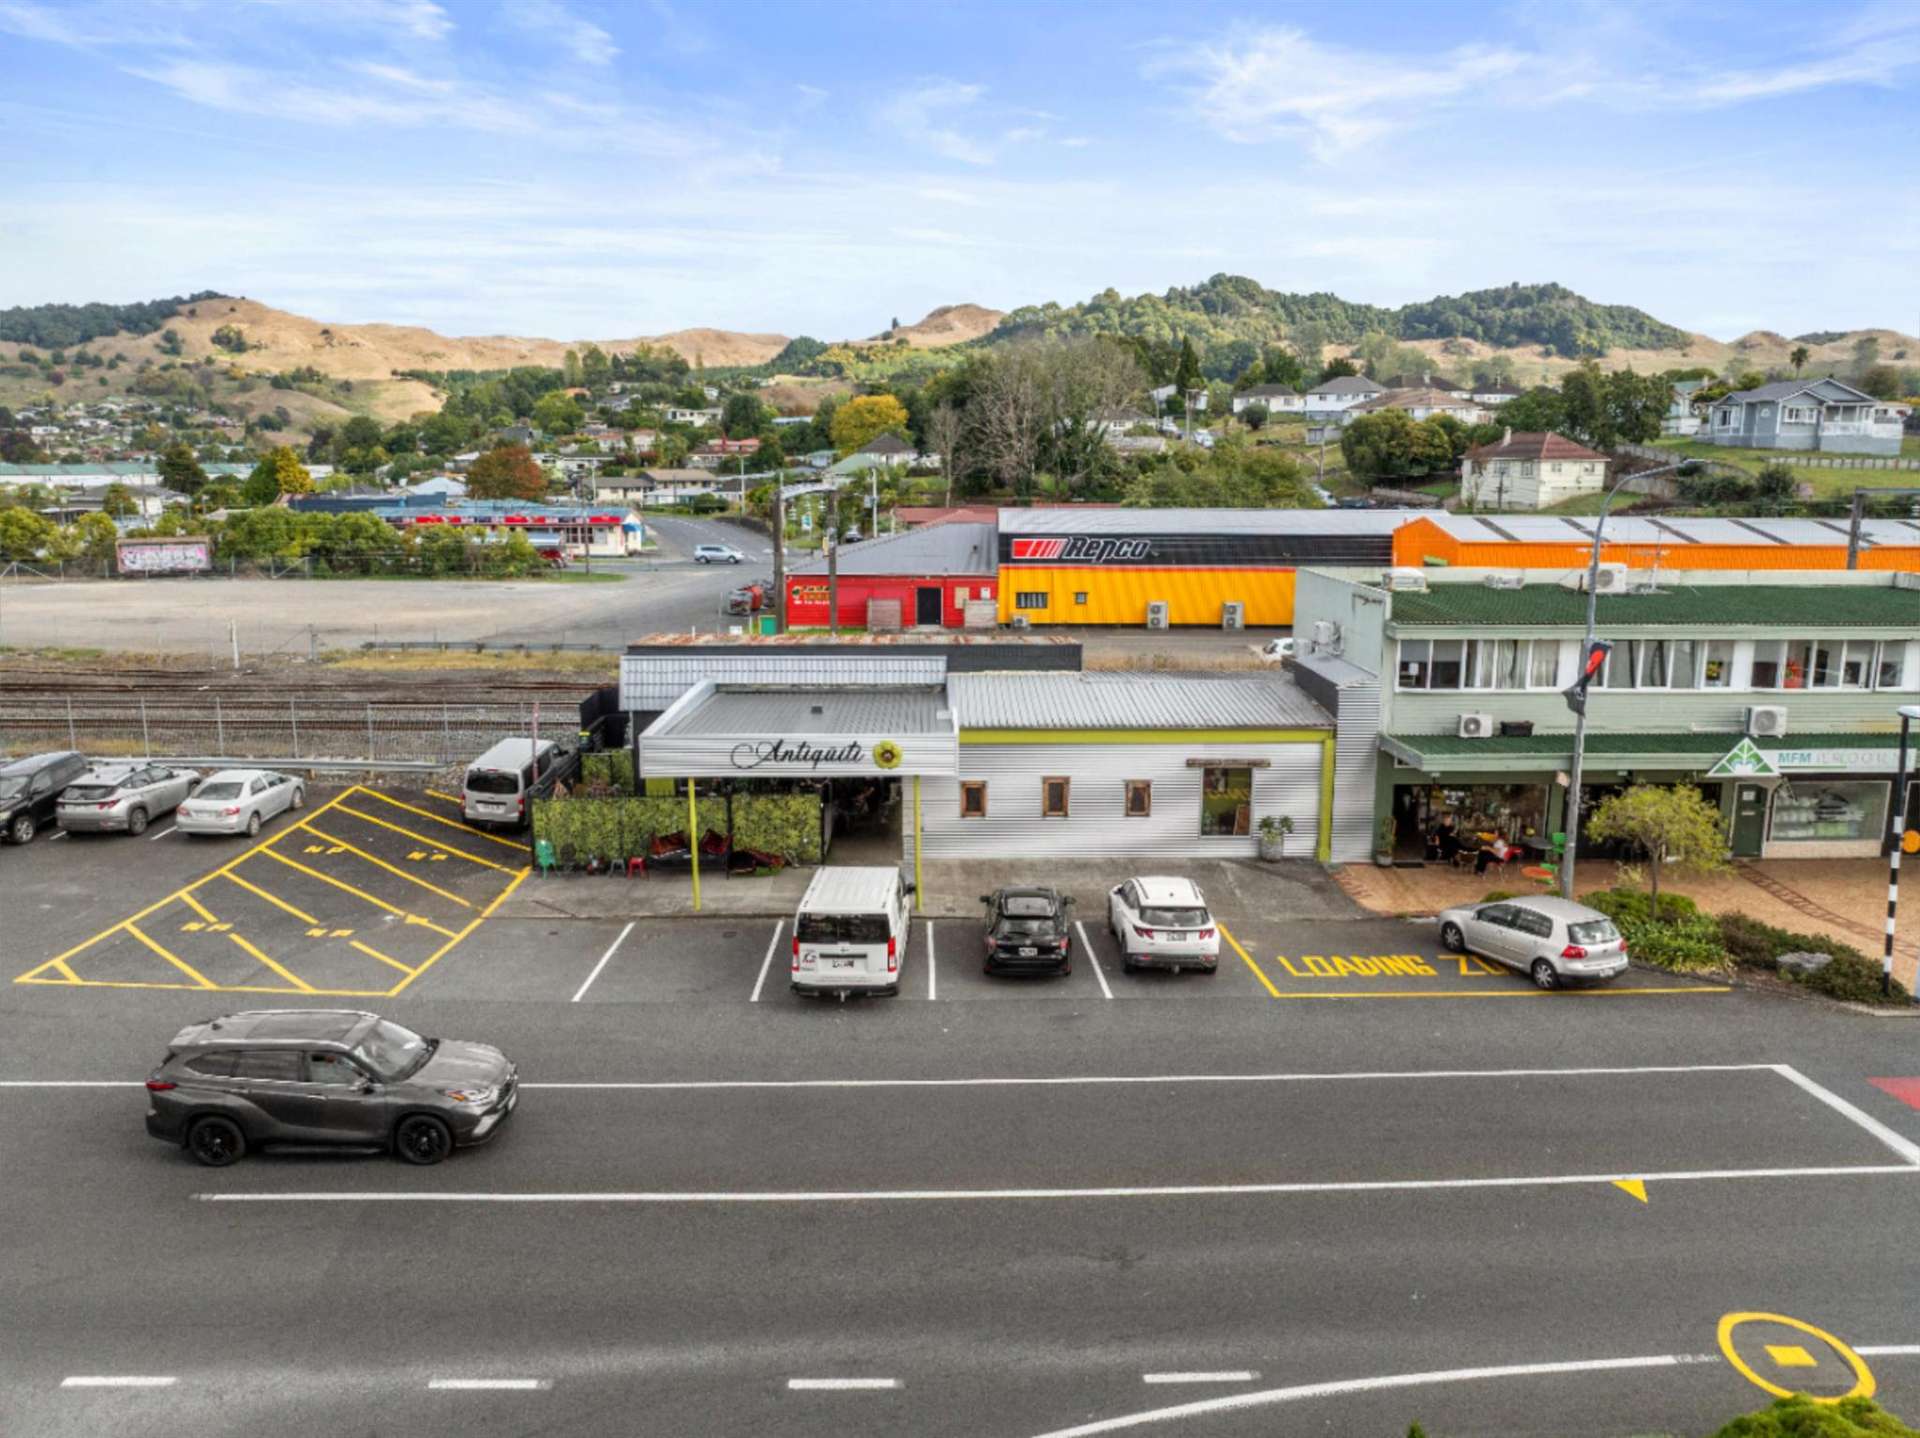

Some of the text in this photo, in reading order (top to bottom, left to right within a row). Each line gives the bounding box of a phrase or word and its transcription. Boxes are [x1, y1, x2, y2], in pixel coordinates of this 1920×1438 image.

[1062, 536, 1151, 563] Repco
[1778, 752, 1811, 764] MFM
[1276, 954, 1439, 977] LOADING
